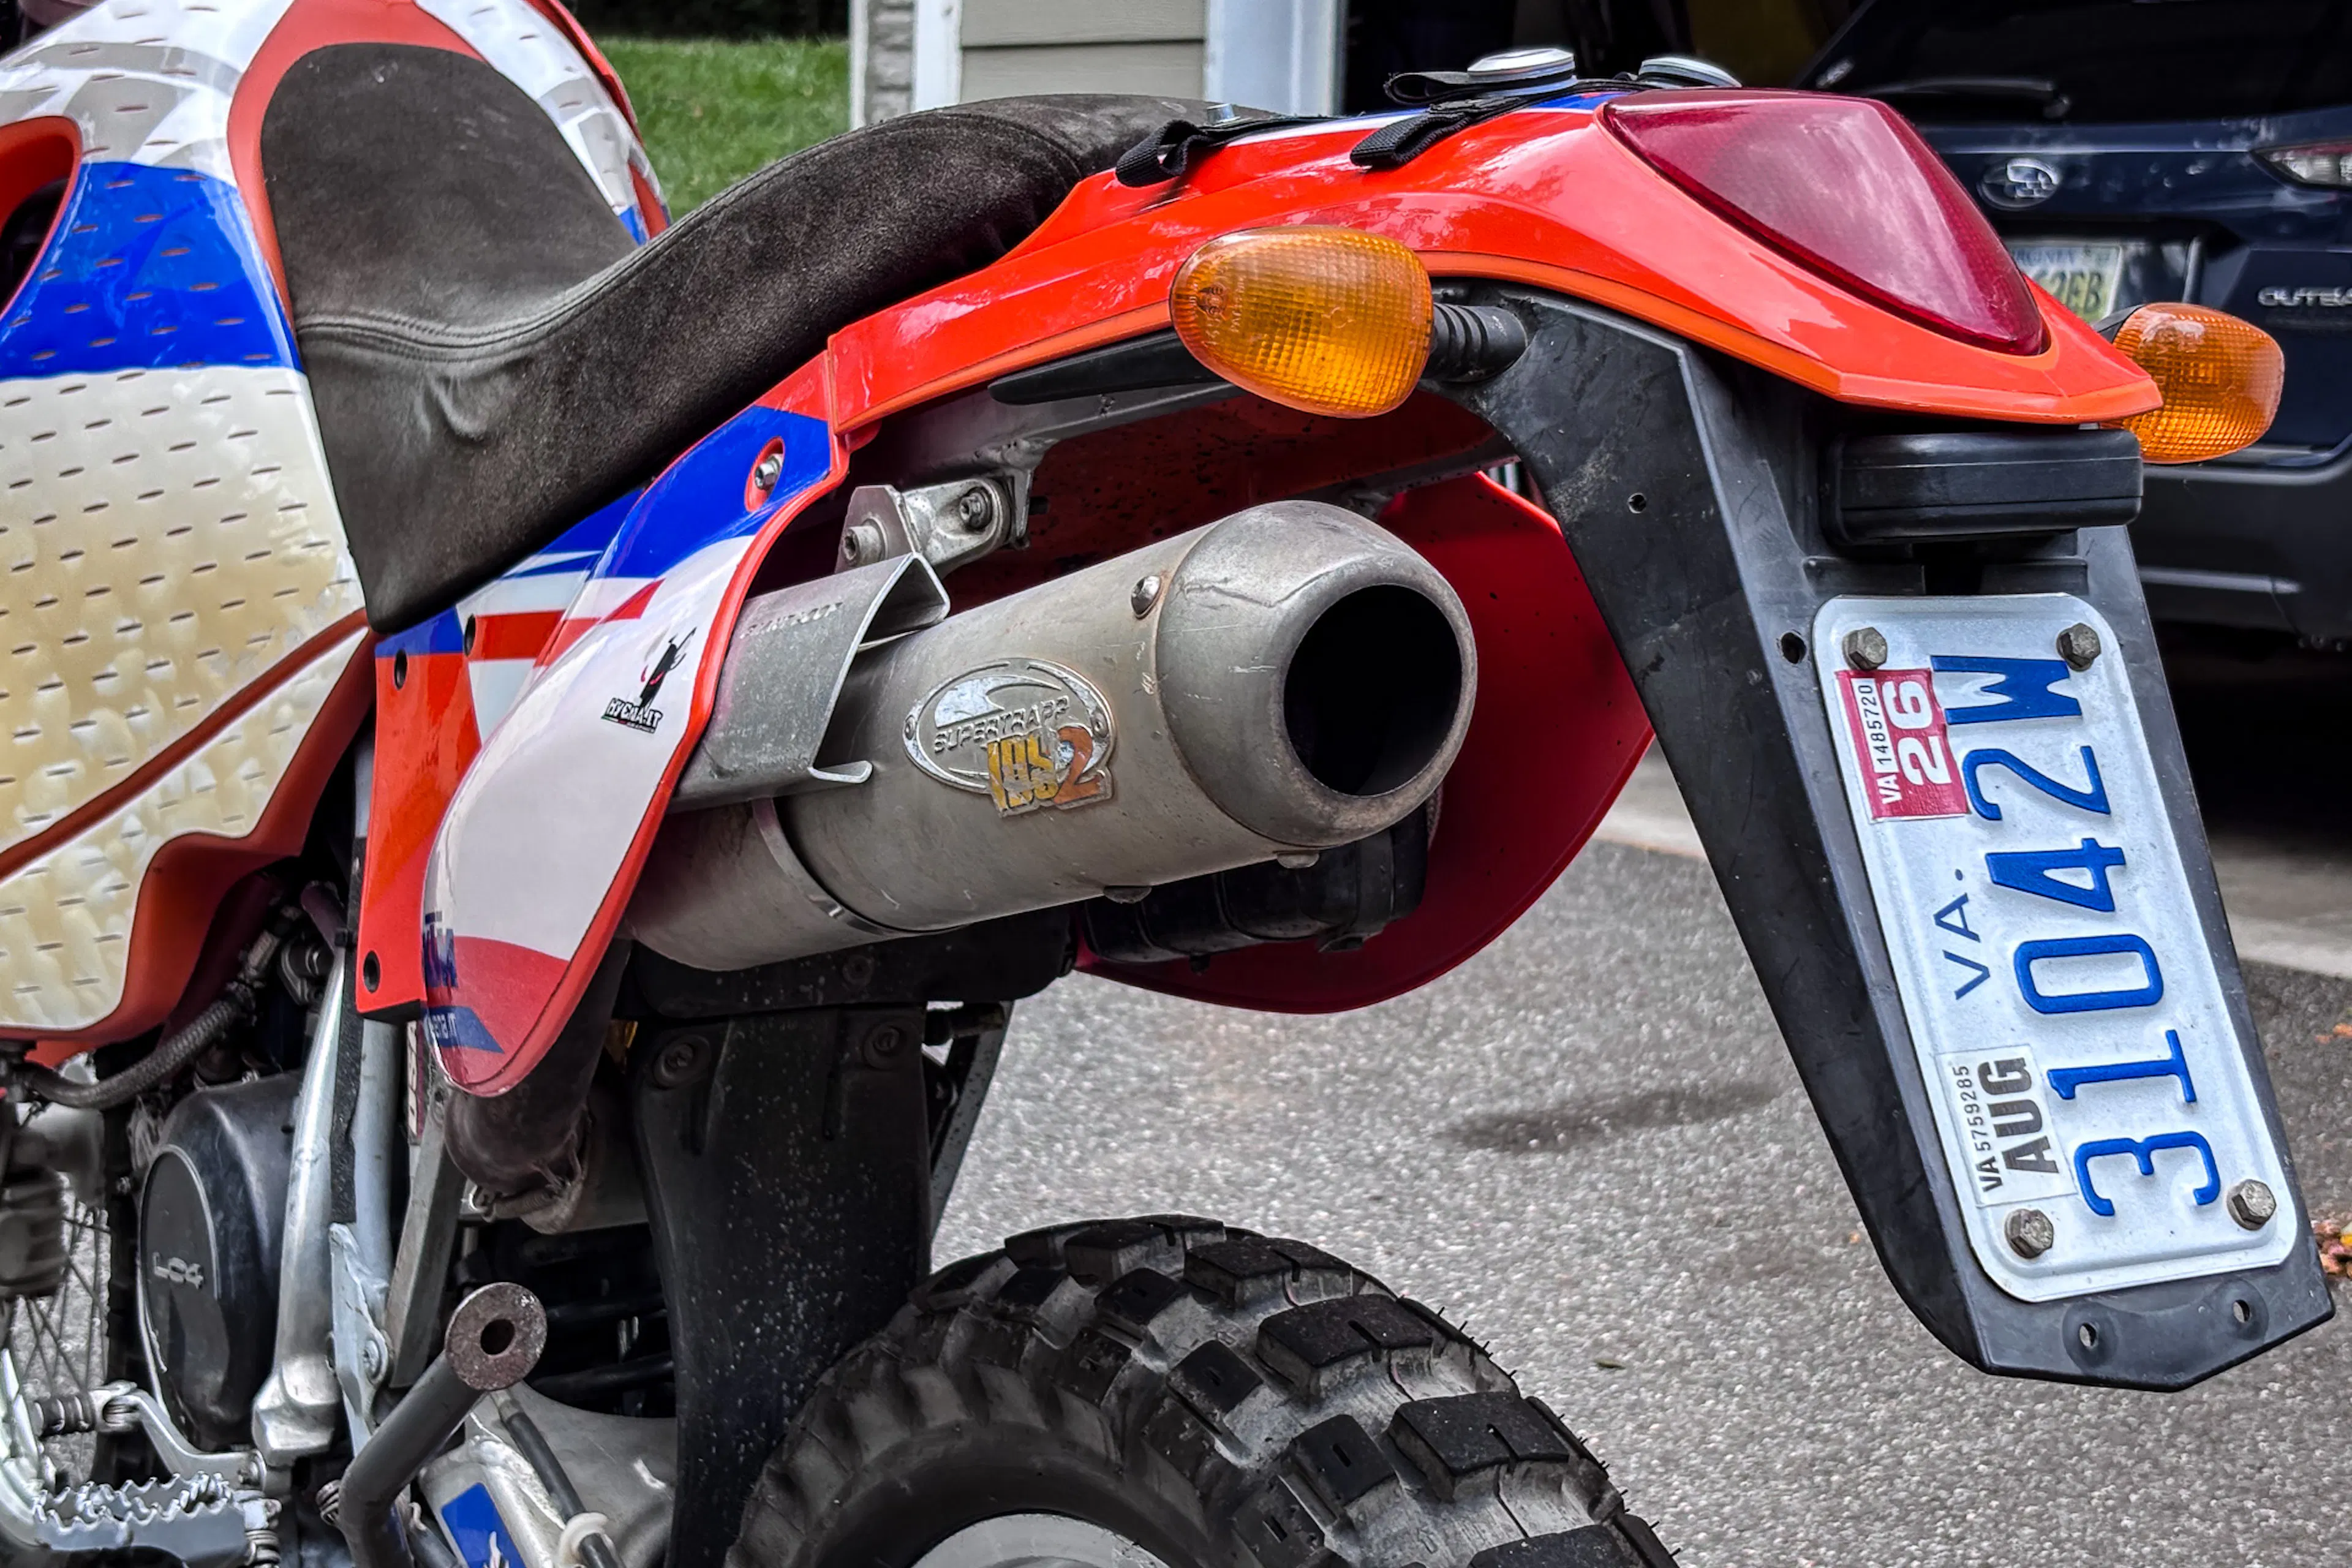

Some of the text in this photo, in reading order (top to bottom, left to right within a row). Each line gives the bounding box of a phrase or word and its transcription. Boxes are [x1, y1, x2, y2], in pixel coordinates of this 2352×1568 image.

[933, 695, 1069, 754] SUPERTRAPP
[1857, 684, 1903, 804] VA 1485720
[1881, 679, 1953, 786] 26
[1929, 654, 2222, 1217] 31042W
[1952, 1066, 2003, 1193] VA 5759285
[1977, 1057, 2059, 1174] AUG
